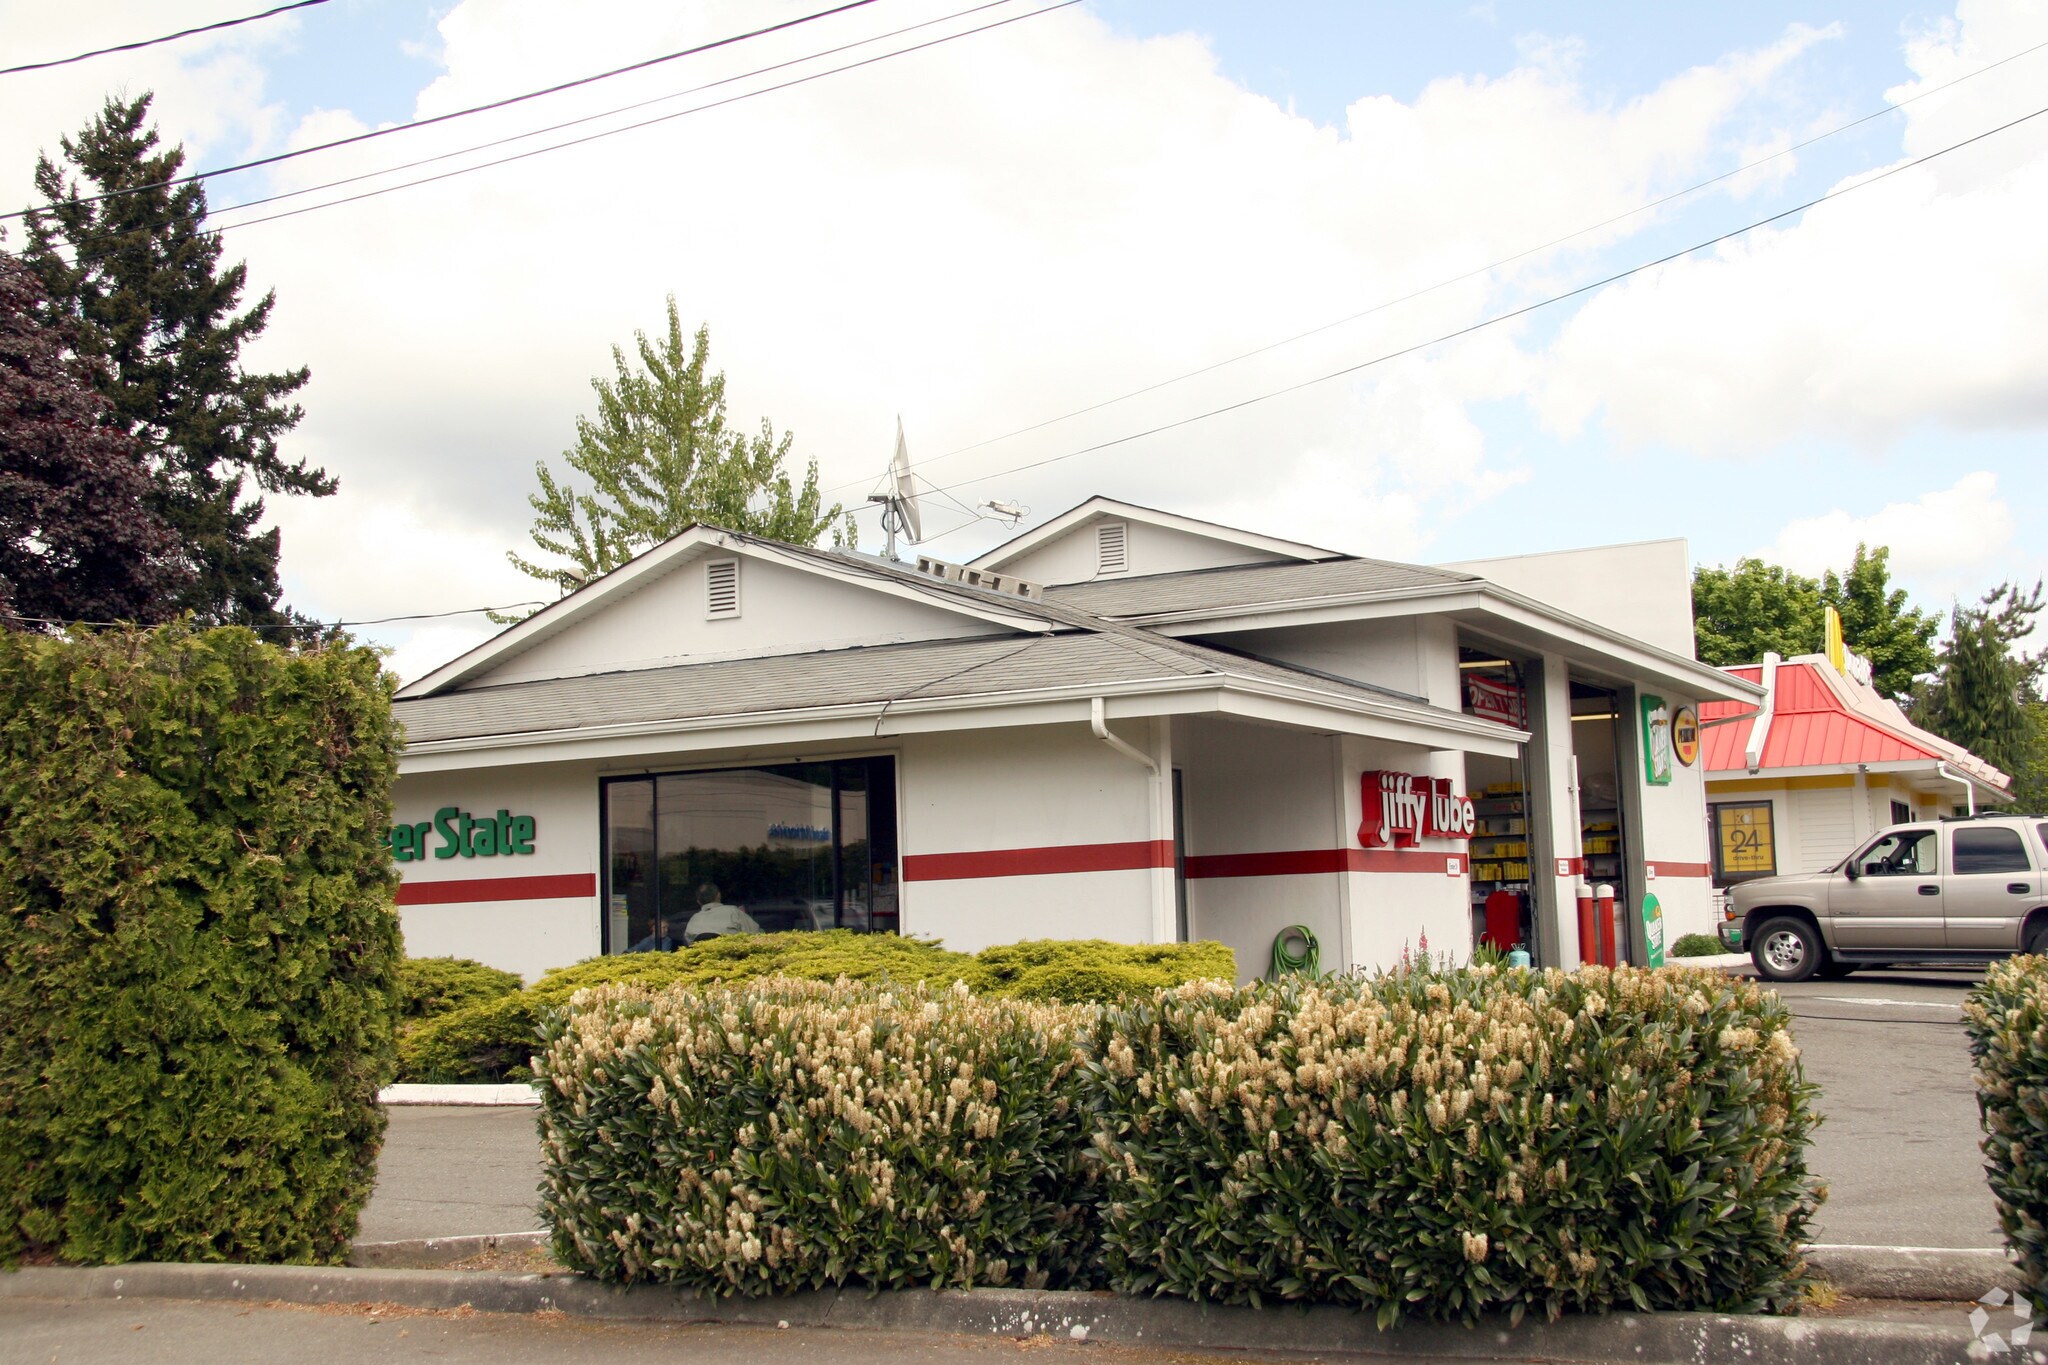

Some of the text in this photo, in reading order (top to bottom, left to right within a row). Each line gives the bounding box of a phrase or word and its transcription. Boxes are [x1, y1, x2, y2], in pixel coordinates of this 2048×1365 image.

[434, 807, 536, 859] State
[1379, 774, 1475, 843] jiffy lube
[1730, 829, 1763, 853] 24
